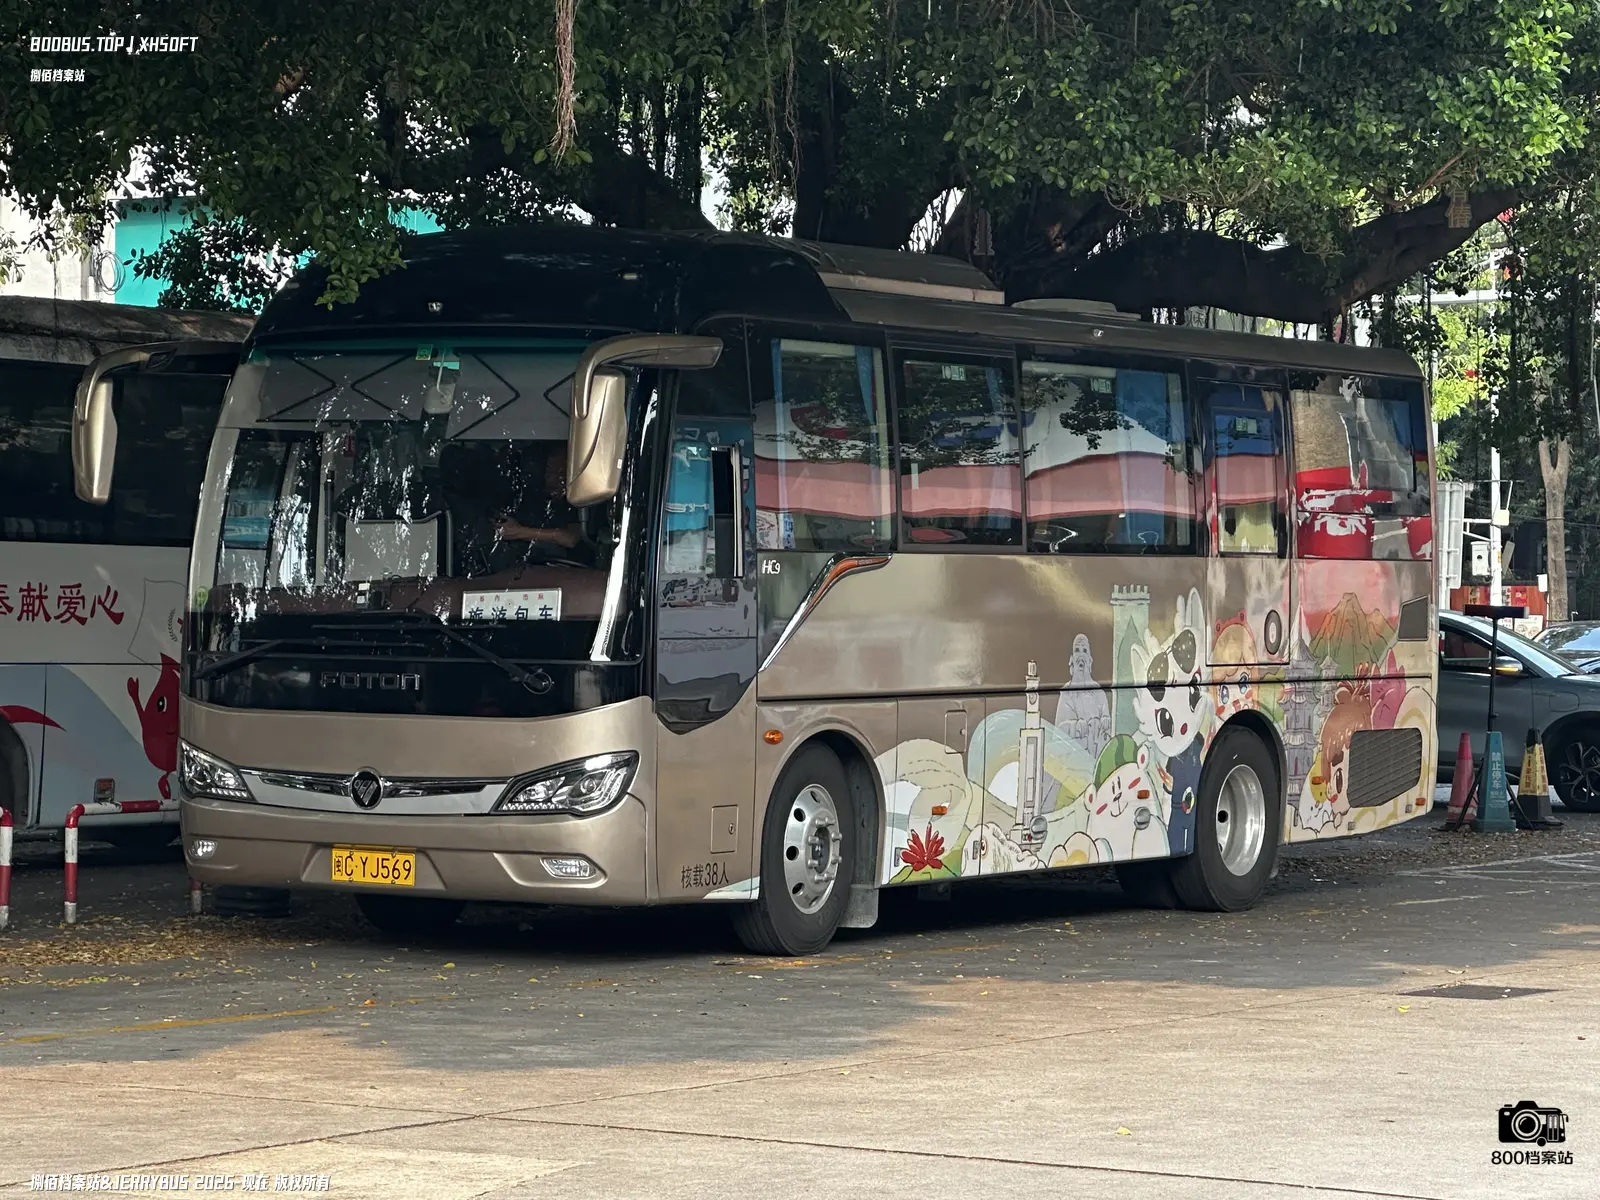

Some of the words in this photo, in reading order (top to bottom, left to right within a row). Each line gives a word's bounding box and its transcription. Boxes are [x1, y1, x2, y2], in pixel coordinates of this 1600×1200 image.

[320, 671, 420, 690] FOTON
[681, 861, 729, 889] 核载38人
